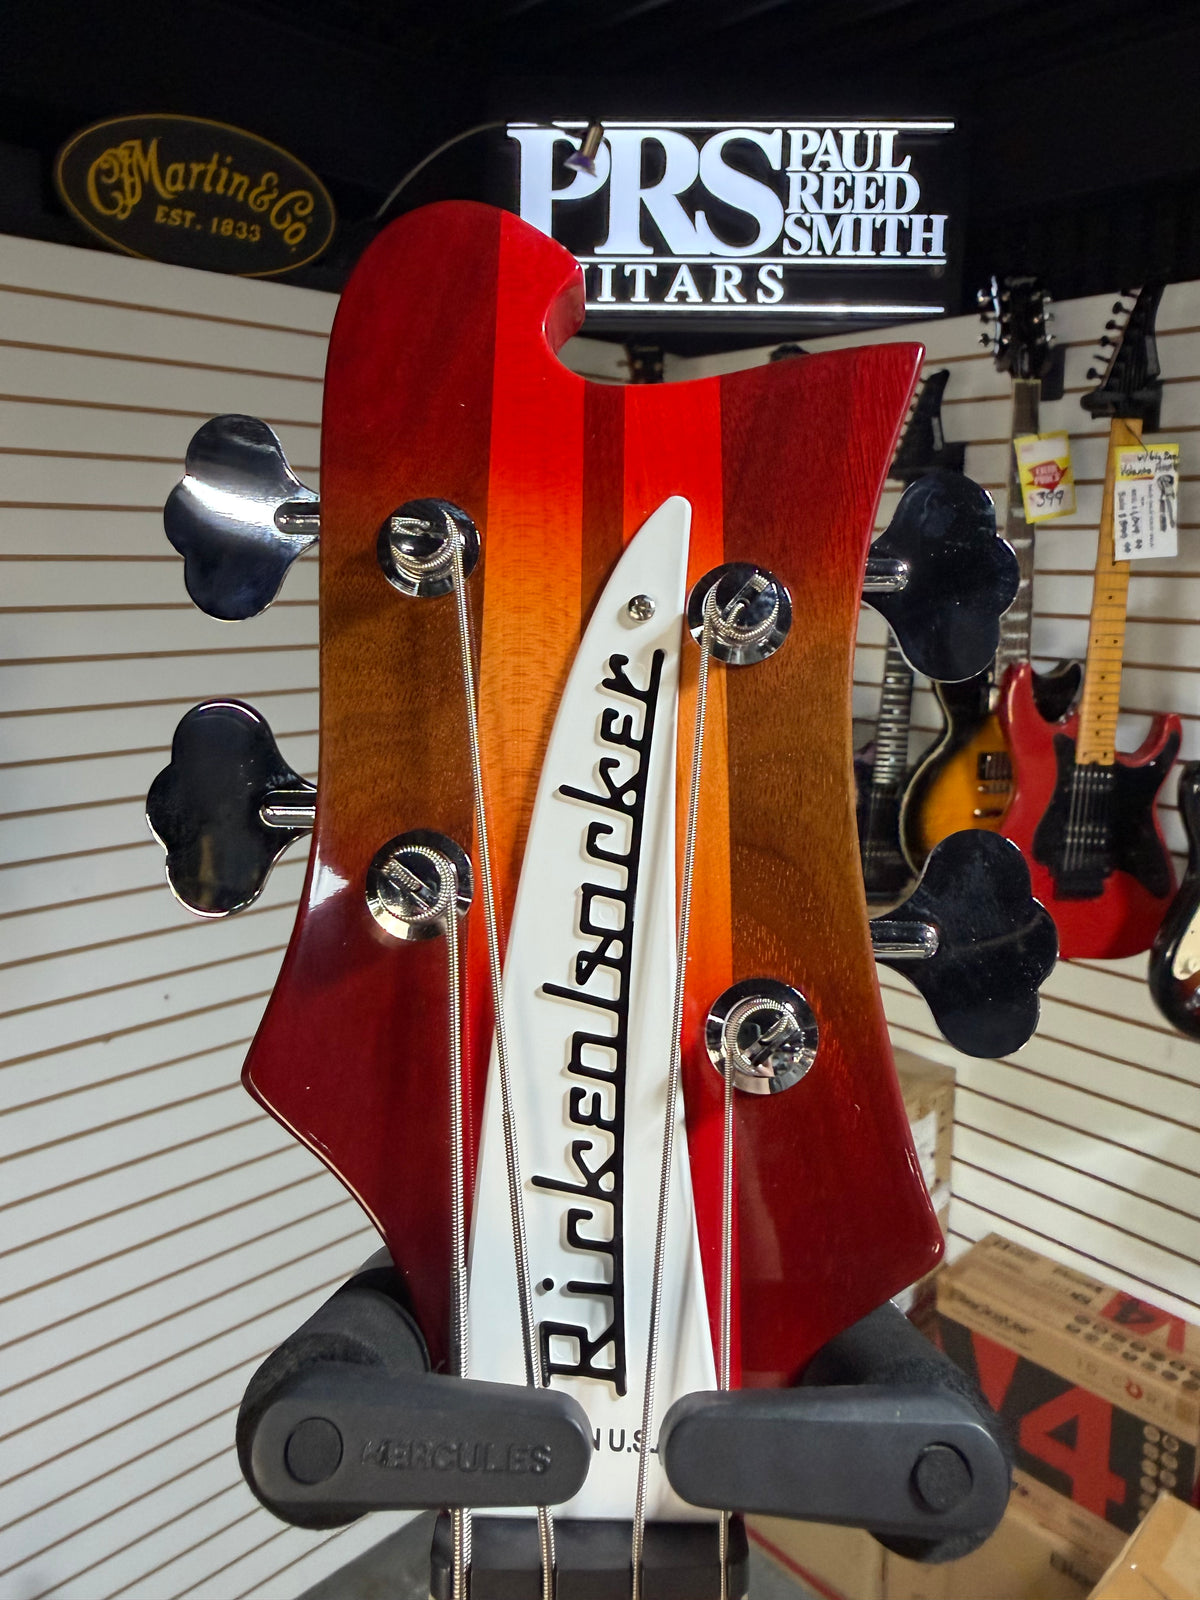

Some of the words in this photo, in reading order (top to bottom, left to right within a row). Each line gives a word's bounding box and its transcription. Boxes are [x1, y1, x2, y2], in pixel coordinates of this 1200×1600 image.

[787, 129, 911, 172] PAUL
[507, 128, 783, 257] PRS
[785, 172, 921, 215] REED
[155, 205, 202, 230] EST.
[211, 217, 262, 242] 1833
[783, 214, 948, 257] SMITH
[583, 263, 784, 304] ITARS
[1036, 489, 1065, 507] 399
[531, 648, 666, 1397] Rickenbacker
[360, 1439, 551, 1475] HERCULES
